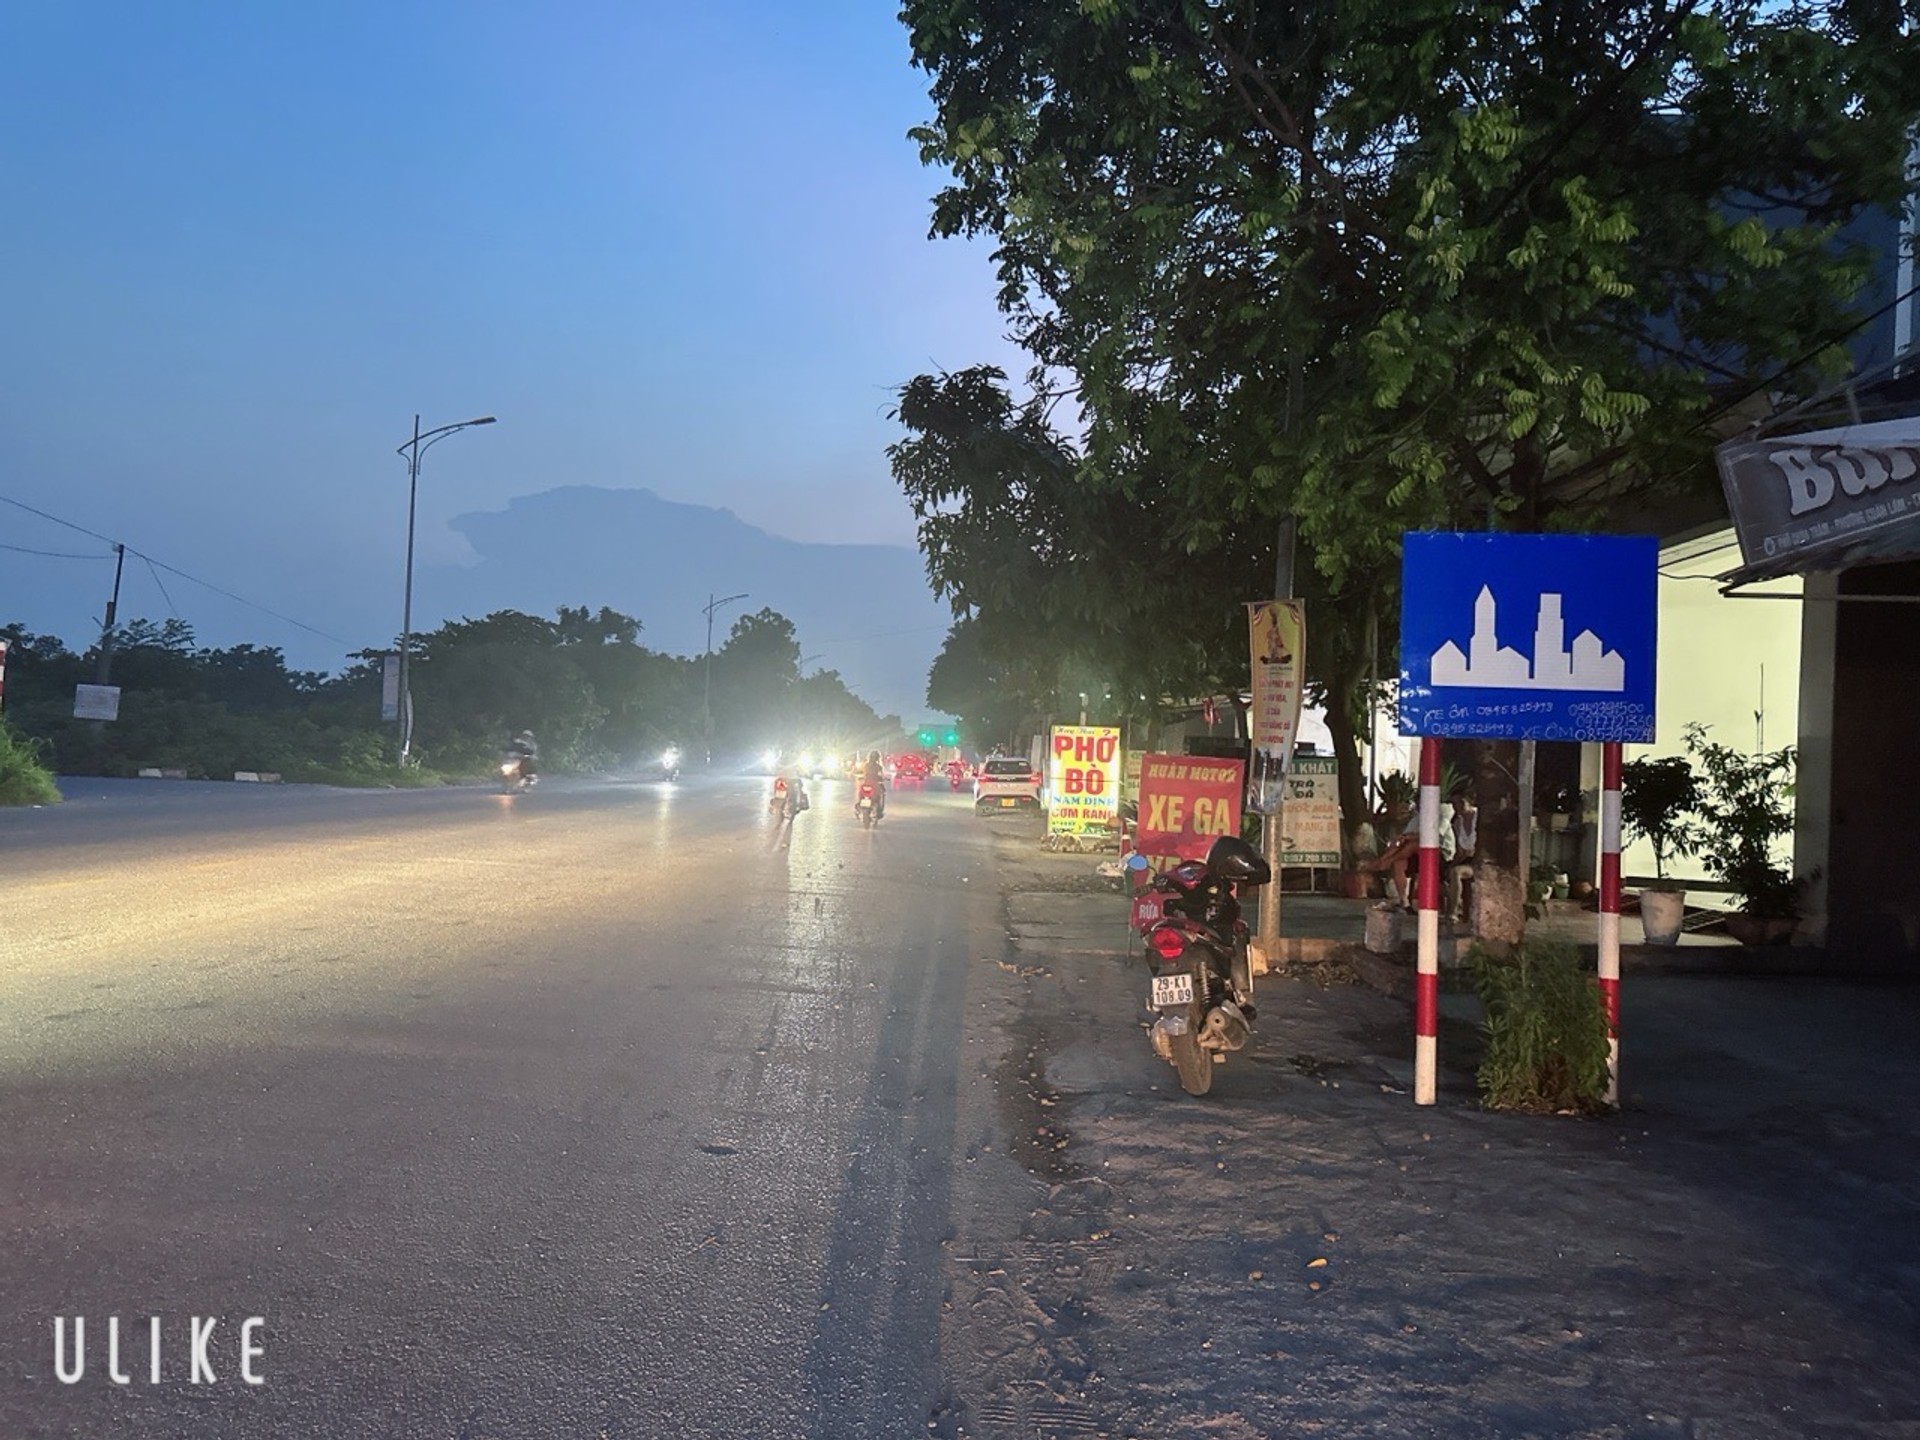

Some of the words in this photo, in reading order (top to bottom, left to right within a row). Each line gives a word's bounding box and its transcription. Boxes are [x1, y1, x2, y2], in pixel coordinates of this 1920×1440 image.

[1054, 729, 1118, 763] PHỞ
[1065, 763, 1104, 795] BÒ
[1299, 760, 1333, 774] KHÁT
[1054, 796, 1080, 806] NAM
[1146, 794, 1184, 833] XE
[1193, 797, 1232, 836] GA
